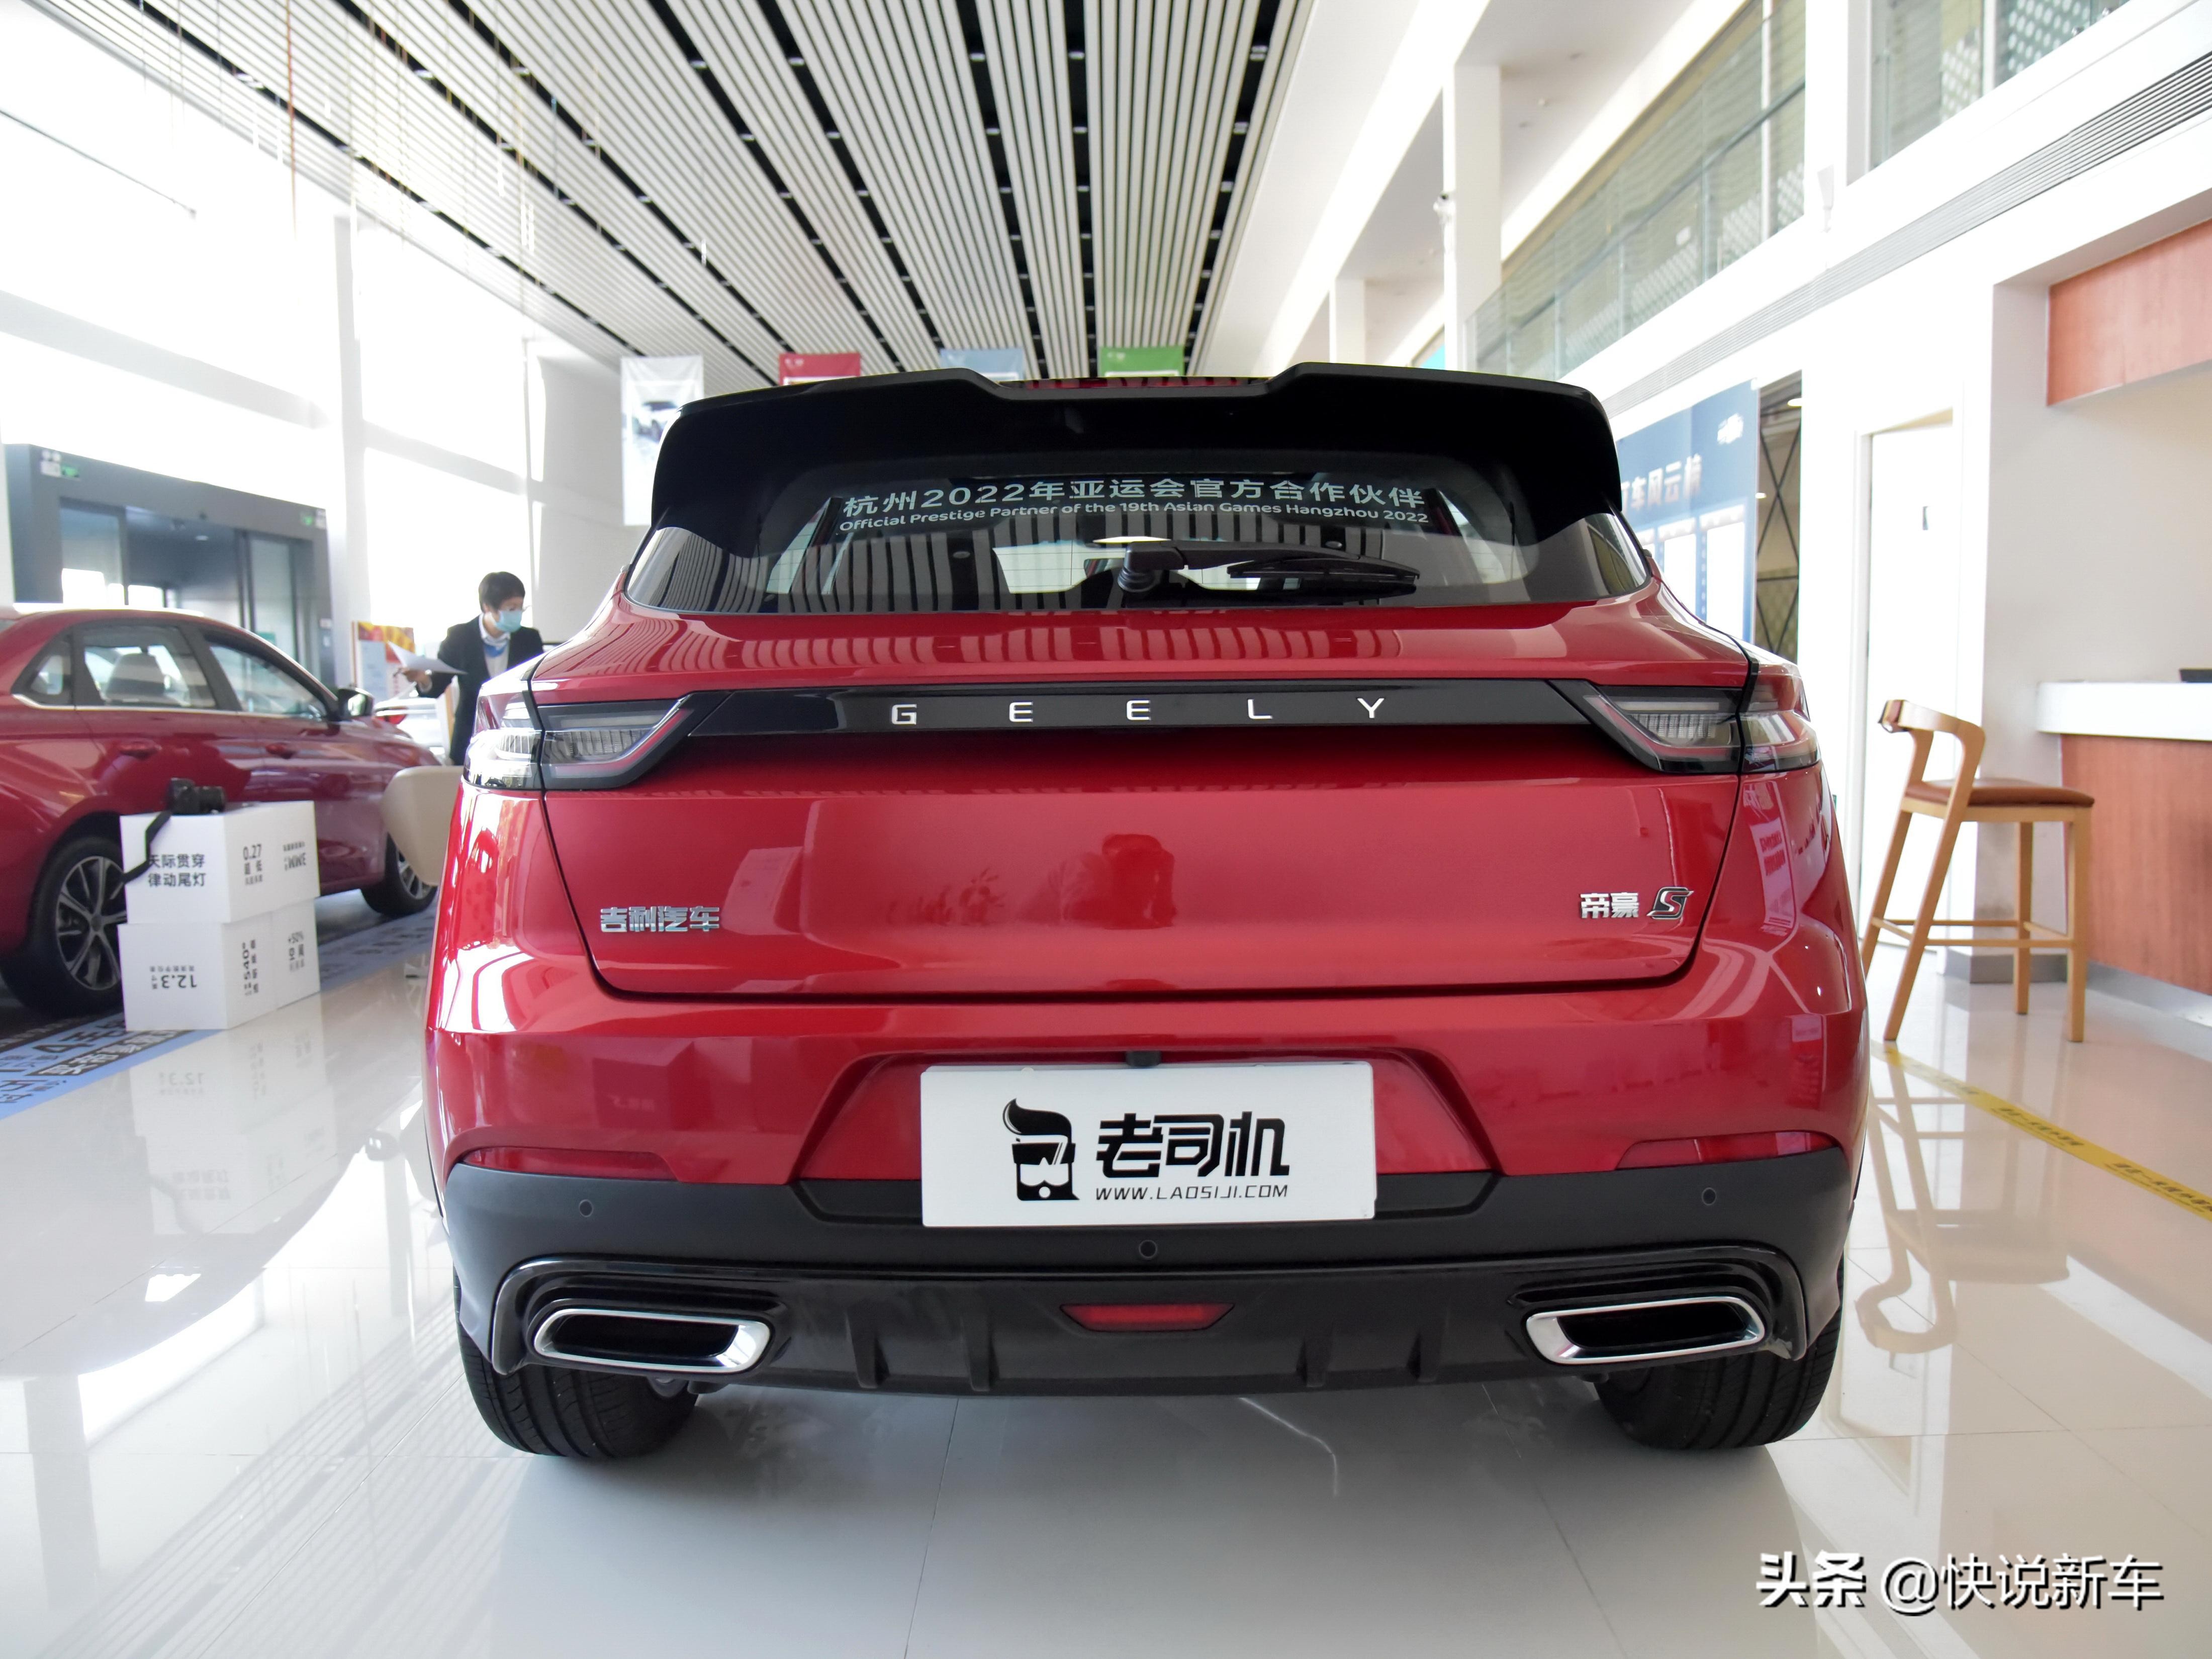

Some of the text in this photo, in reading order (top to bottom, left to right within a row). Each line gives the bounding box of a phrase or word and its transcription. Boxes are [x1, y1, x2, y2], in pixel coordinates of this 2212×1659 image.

[843, 479, 1425, 517] 杭州2022年亚运会官方合作伙伴
[840, 502, 1429, 531] Official Prestige Partner of the 19th Asian Games Hangzhou 2022
[891, 698, 1385, 725] GEELY
[243, 843, 262, 860] 0.27
[148, 872, 207, 887] 律动尾灯
[1580, 886, 1694, 920] 帝豪 S
[601, 906, 719, 932] 吉利汽车
[161, 974, 197, 989] 12.3
[1096, 1111, 1290, 1178] 老司机
[1095, 1184, 1288, 1201] WWW.LAOSIJI.COM
